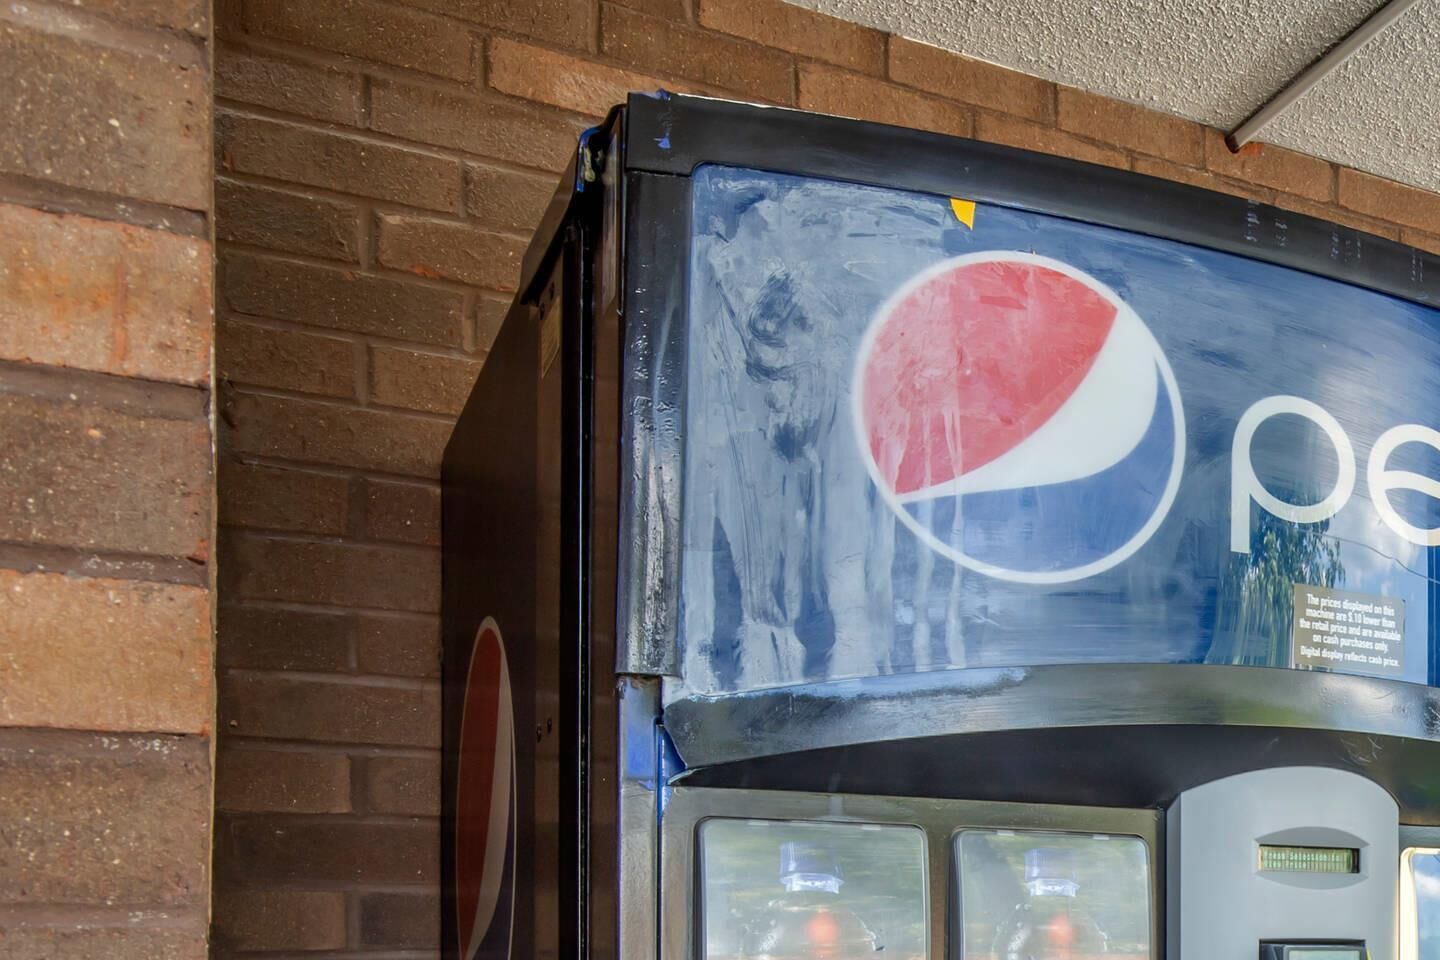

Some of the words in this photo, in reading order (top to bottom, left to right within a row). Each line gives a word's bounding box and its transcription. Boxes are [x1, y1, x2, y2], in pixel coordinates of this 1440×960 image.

[1307, 593, 1319, 605] The
[1320, 597, 1341, 611] prices
[1343, 600, 1373, 614] displayed
[1374, 605, 1382, 614] on
[1383, 605, 1395, 616] this
[1306, 608, 1335, 620] machine
[1336, 612, 1347, 621] are
[1363, 612, 1380, 626] lower
[1382, 617, 1396, 628] than
[1299, 618, 1310, 628] the
[1311, 621, 1329, 631] retail
[1330, 623, 1347, 635] price
[1348, 626, 1360, 636] and
[1362, 628, 1373, 637] are
[1374, 630, 1401, 641] available
[1313, 634, 1322, 643] on
[1323, 635, 1339, 645] cash
[1341, 637, 1373, 649] purchases
[1300, 645, 1321, 658] Digital
[1322, 648, 1343, 661] display
[1344, 651, 1367, 663] reflects
[1368, 655, 1382, 665] cash
